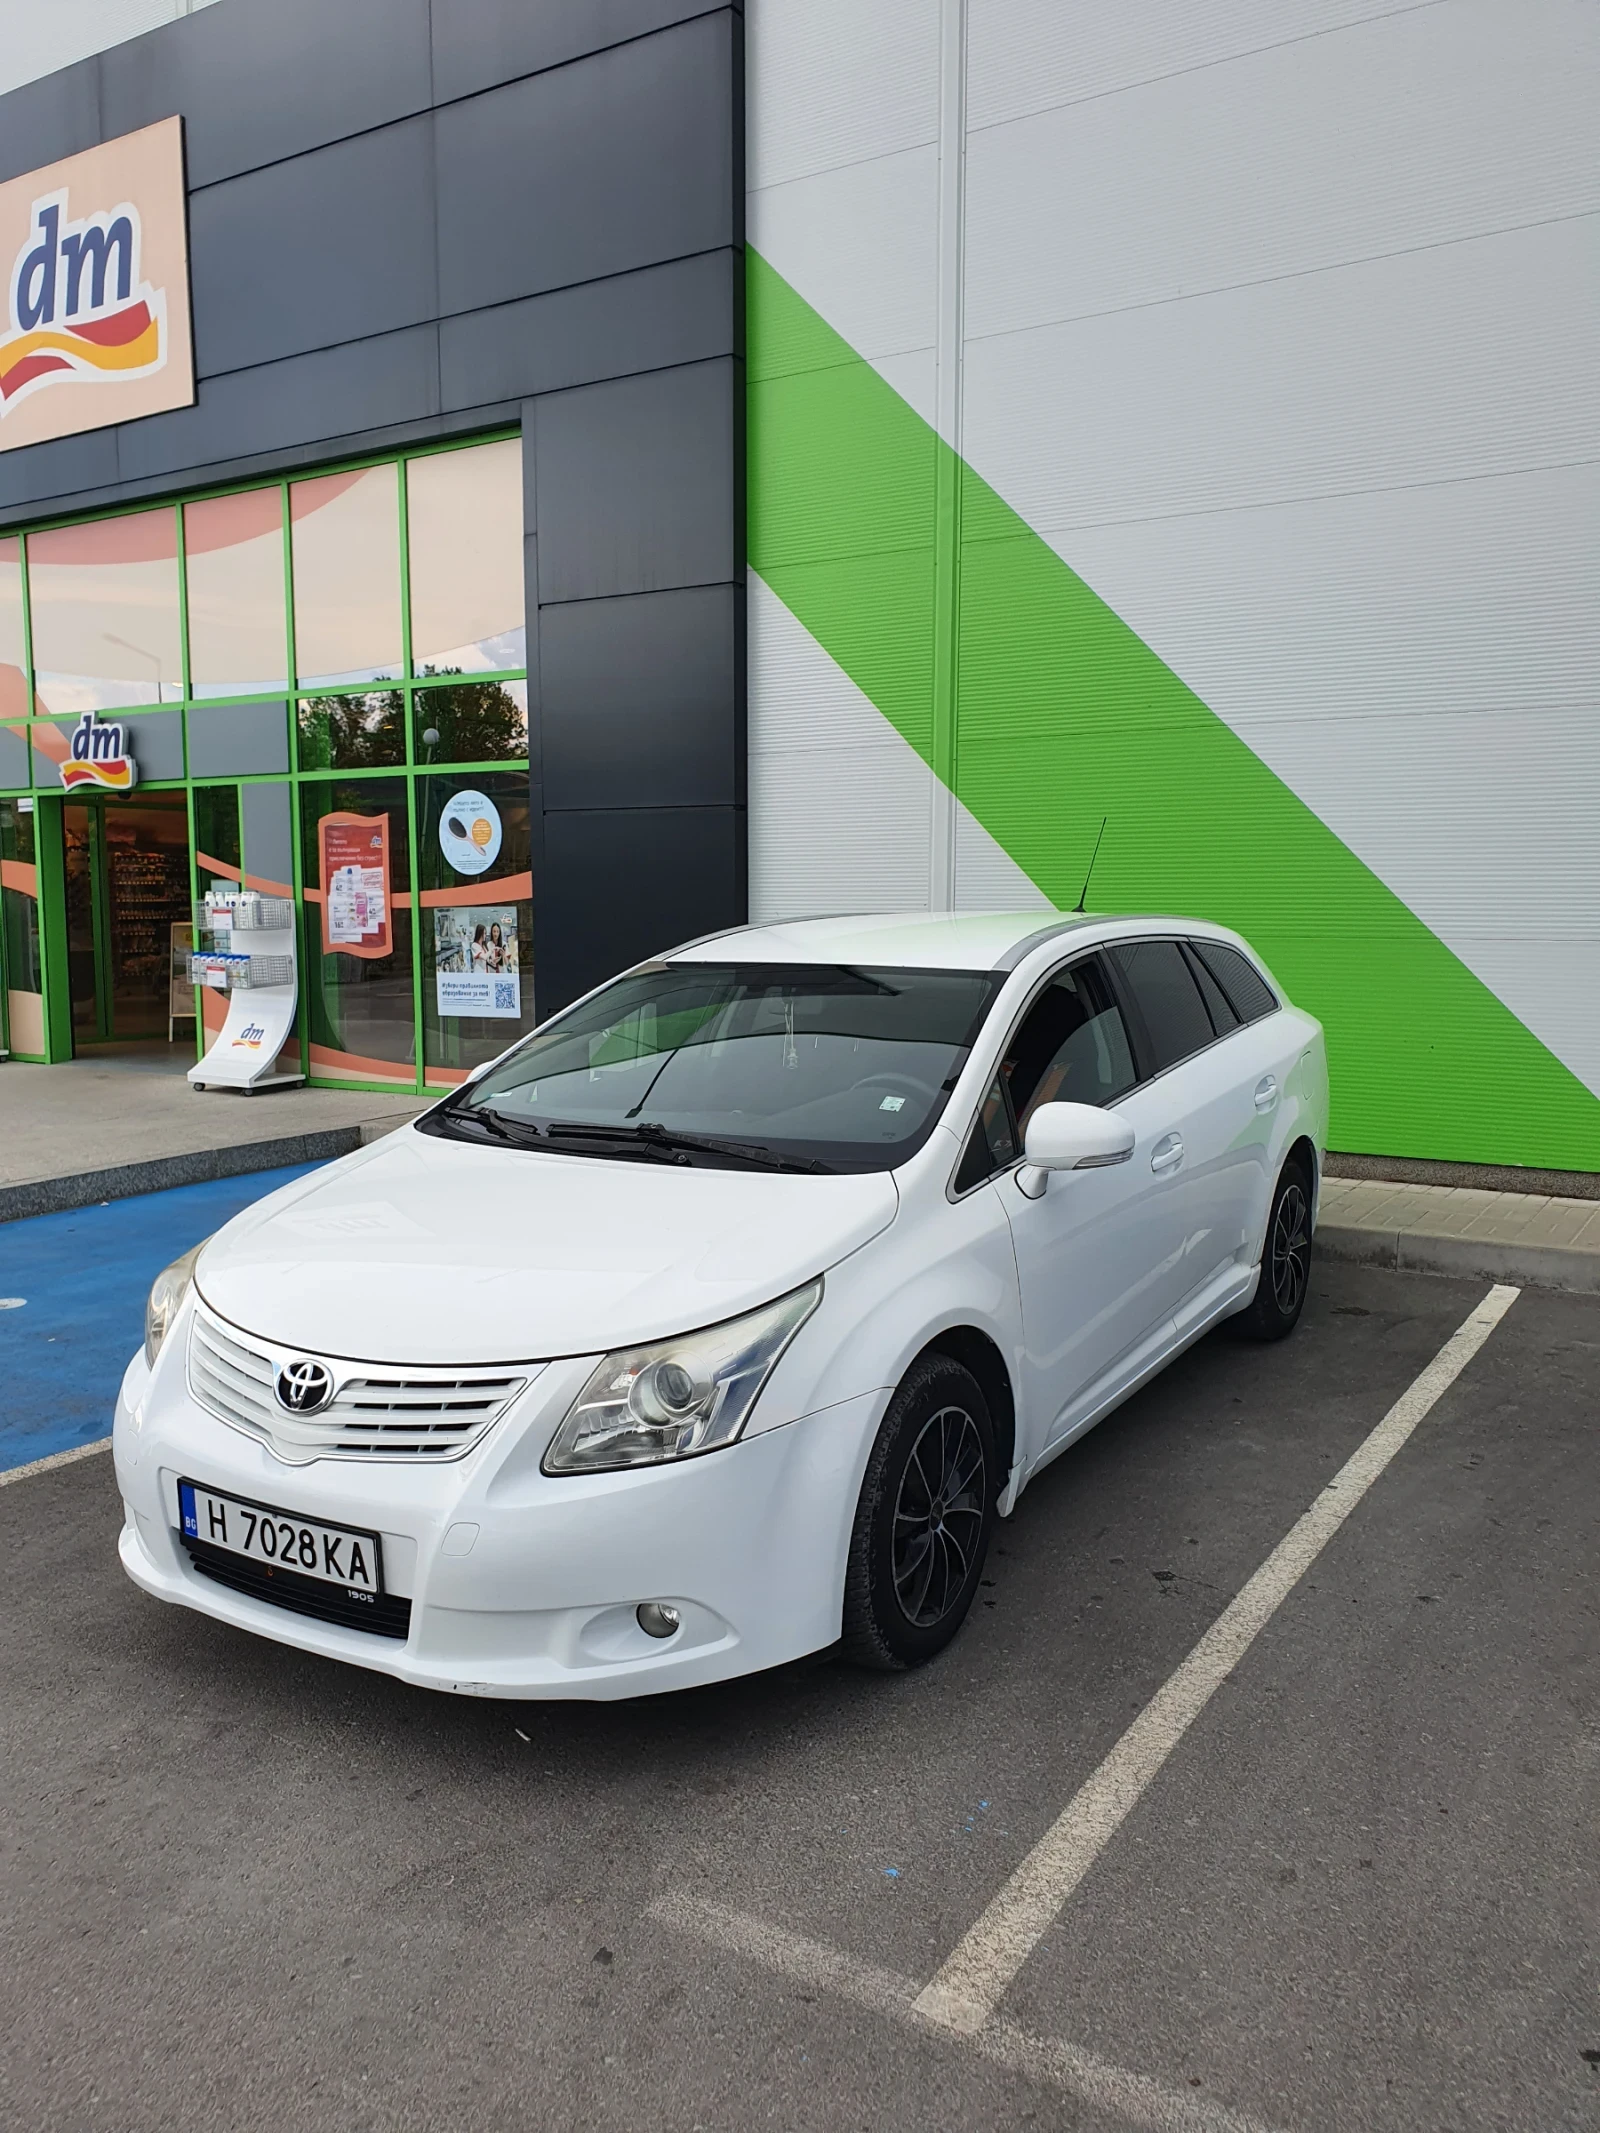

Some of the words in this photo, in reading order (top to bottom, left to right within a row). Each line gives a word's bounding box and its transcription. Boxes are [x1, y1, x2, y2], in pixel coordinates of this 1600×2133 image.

[17, 204, 133, 331] dm
[72, 714, 121, 761] dm
[240, 1023, 265, 1040] dm
[185, 1516, 197, 1530] BG
[347, 1589, 375, 1604] 1905
